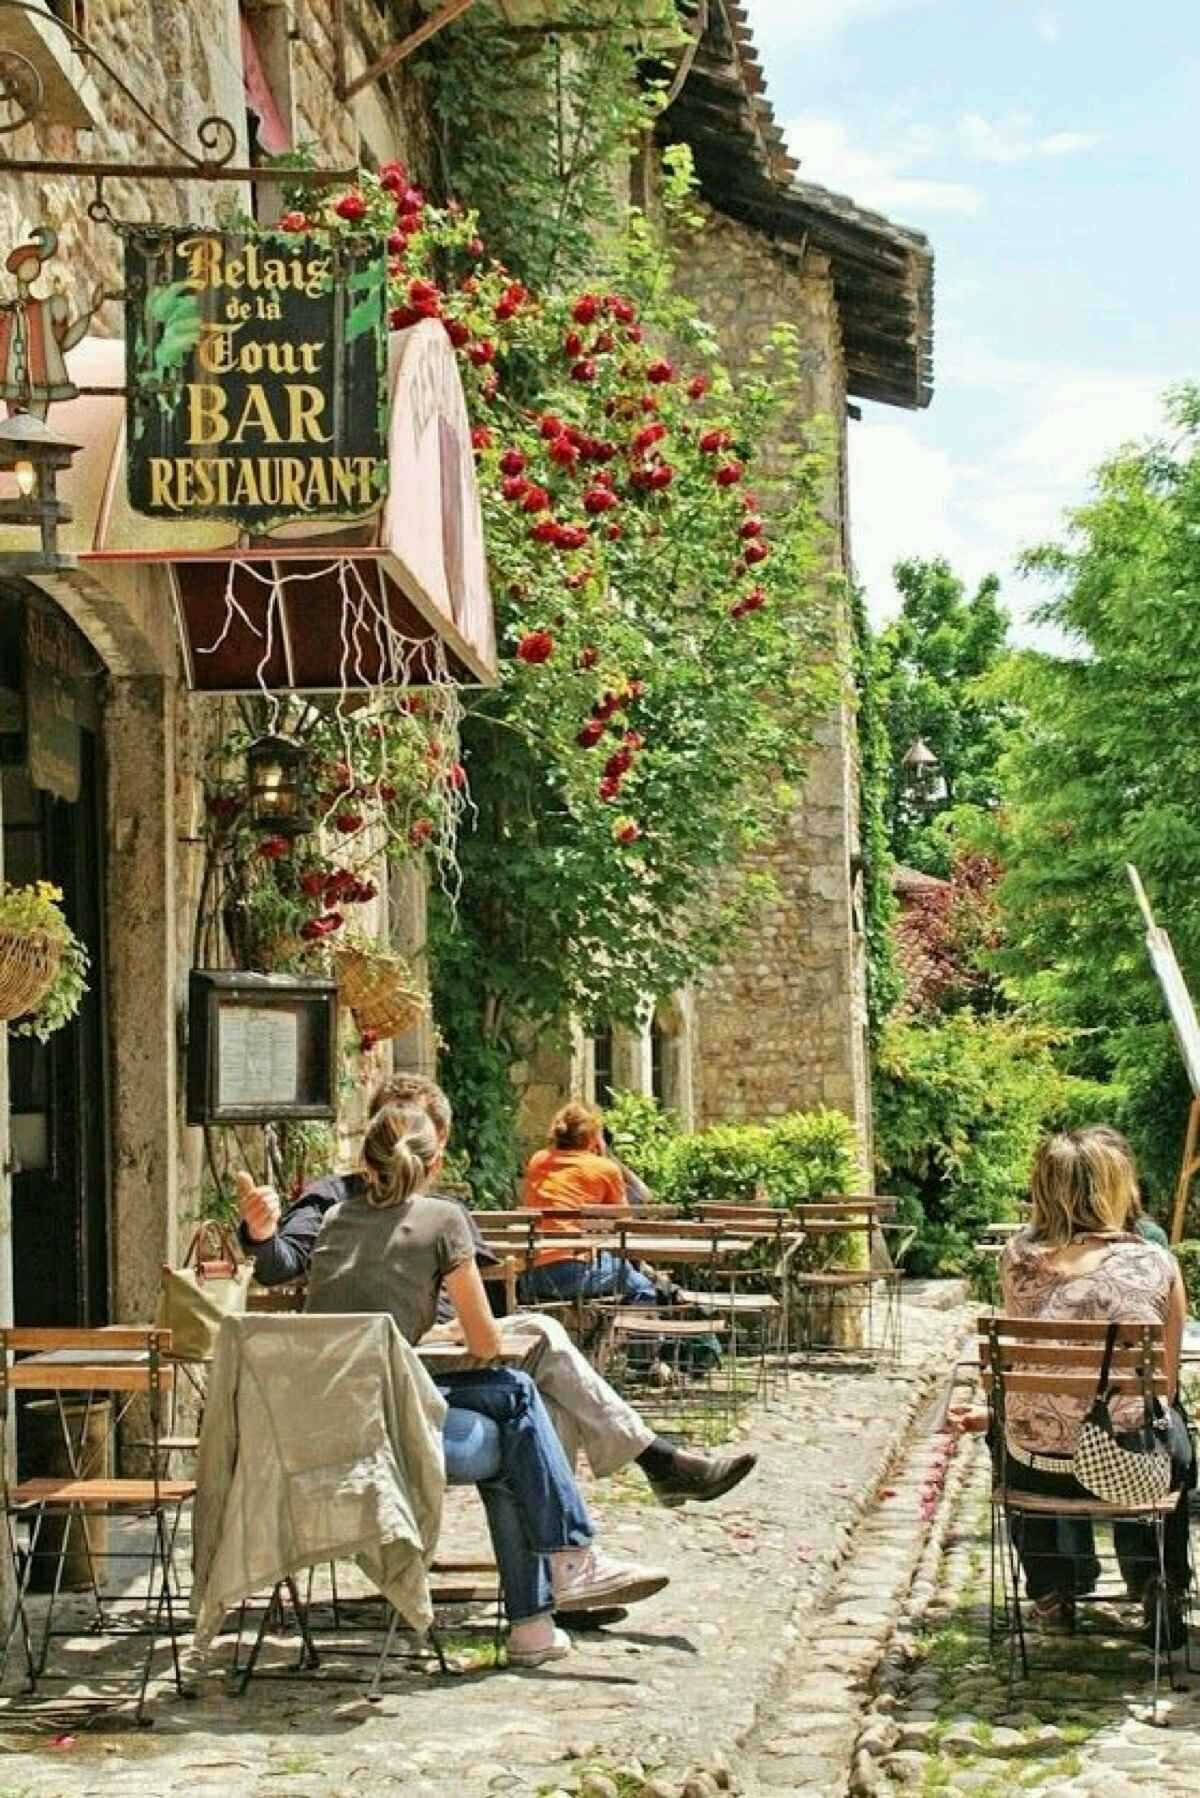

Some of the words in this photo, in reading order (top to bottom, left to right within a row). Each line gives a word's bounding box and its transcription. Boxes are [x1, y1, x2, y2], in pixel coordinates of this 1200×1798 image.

[176, 238, 332, 298] Relais
[225, 296, 251, 320] de
[195, 322, 325, 374] Tour
[185, 384, 335, 444] BAR
[149, 457, 377, 511] RESTAURANT
